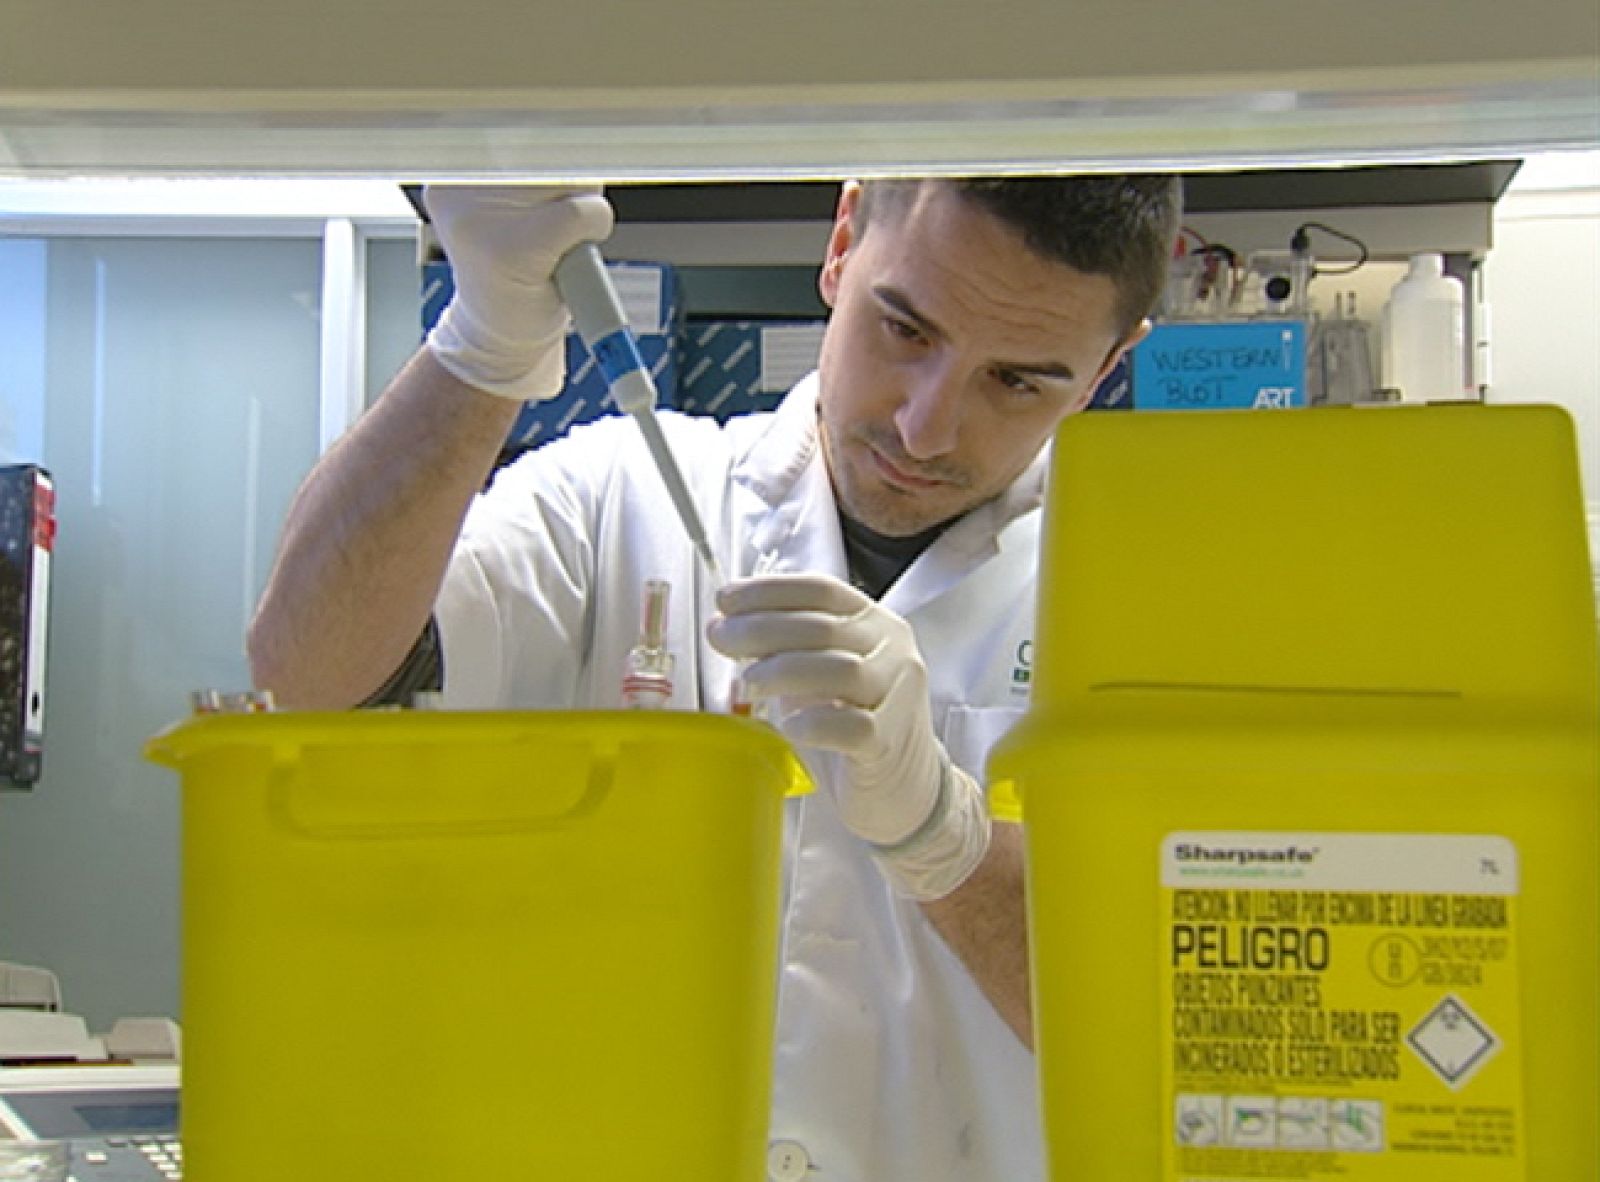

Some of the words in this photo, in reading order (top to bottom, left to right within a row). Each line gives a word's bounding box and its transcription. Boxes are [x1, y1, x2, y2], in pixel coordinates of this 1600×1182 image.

[1152, 347, 1279, 373] WESTERN
[1175, 844, 1314, 865] Sharpsafe
[1254, 890, 1297, 923] LLENAR
[1301, 891, 1326, 924] POR
[1330, 892, 1374, 926] ENCIMA
[1378, 893, 1394, 926] DE
[1172, 925, 1330, 970] PELIGRO
[1173, 971, 1233, 1006] OBJETOS
[1238, 974, 1322, 1008] PUNZANTES
[1173, 1008, 1284, 1040] CONTAMINADOS
[1288, 1010, 1325, 1042] SOLO
[1331, 1011, 1367, 1042] PARA
[1372, 1012, 1401, 1044] SER
[1173, 1042, 1269, 1076] INCINERADOS
[1289, 1045, 1401, 1080] ESTERILIZADOS
